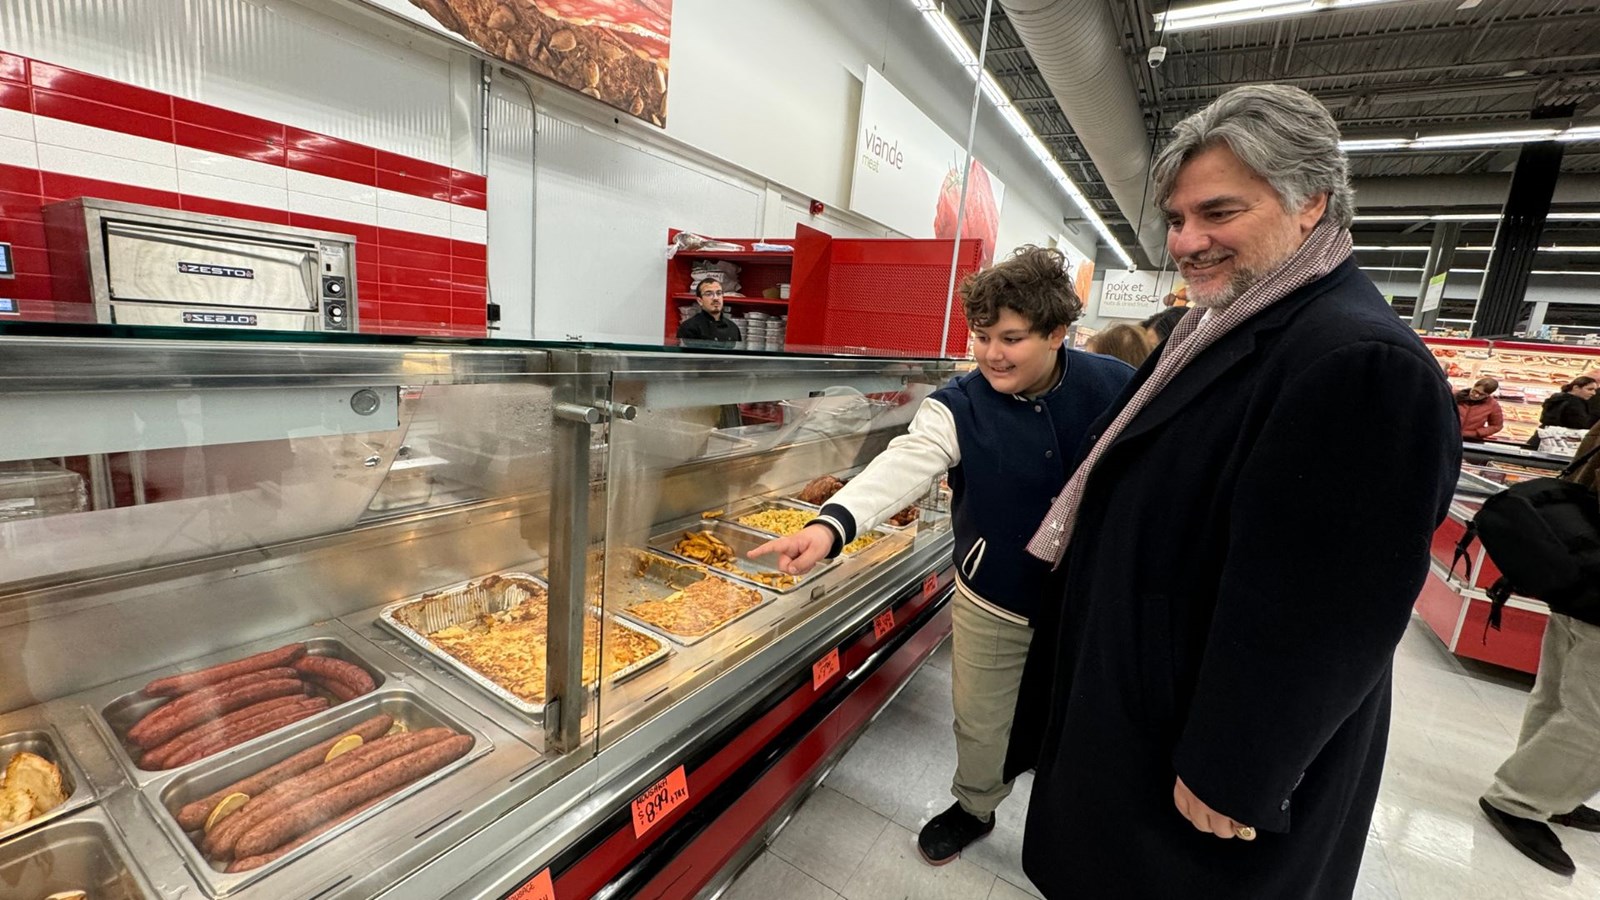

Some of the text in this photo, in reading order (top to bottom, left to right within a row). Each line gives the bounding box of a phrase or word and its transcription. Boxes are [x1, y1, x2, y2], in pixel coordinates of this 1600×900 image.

[865, 125, 903, 170] viande
[862, 154, 879, 173] meat
[187, 264, 246, 277] ZESTO
[1106, 281, 1144, 292] noix et
[1105, 290, 1133, 301] fruits
